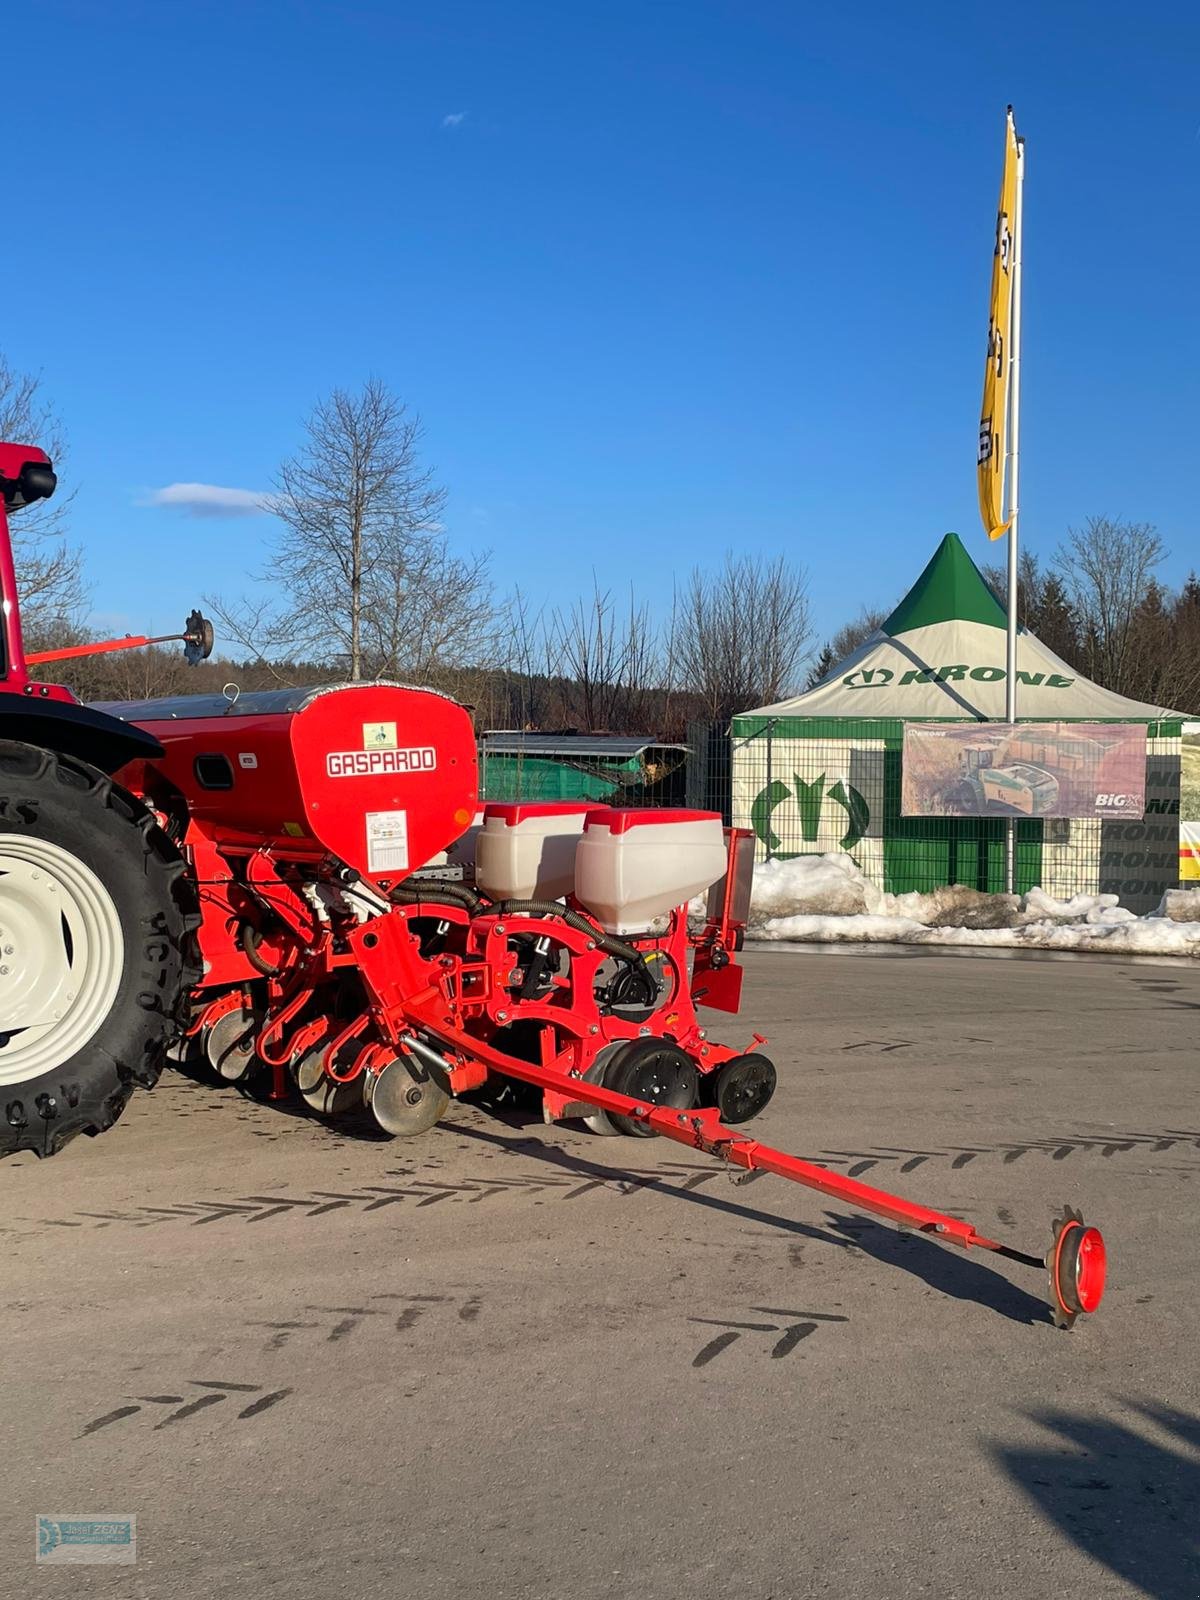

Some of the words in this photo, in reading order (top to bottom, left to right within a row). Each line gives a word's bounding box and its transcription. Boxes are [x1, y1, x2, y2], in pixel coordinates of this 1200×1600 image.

[898, 664, 1075, 688] KRONE
[328, 749, 435, 775] GASPARDO
[1102, 824, 1178, 841] RON
[1101, 851, 1178, 868] RON
[1101, 878, 1178, 895] RON
